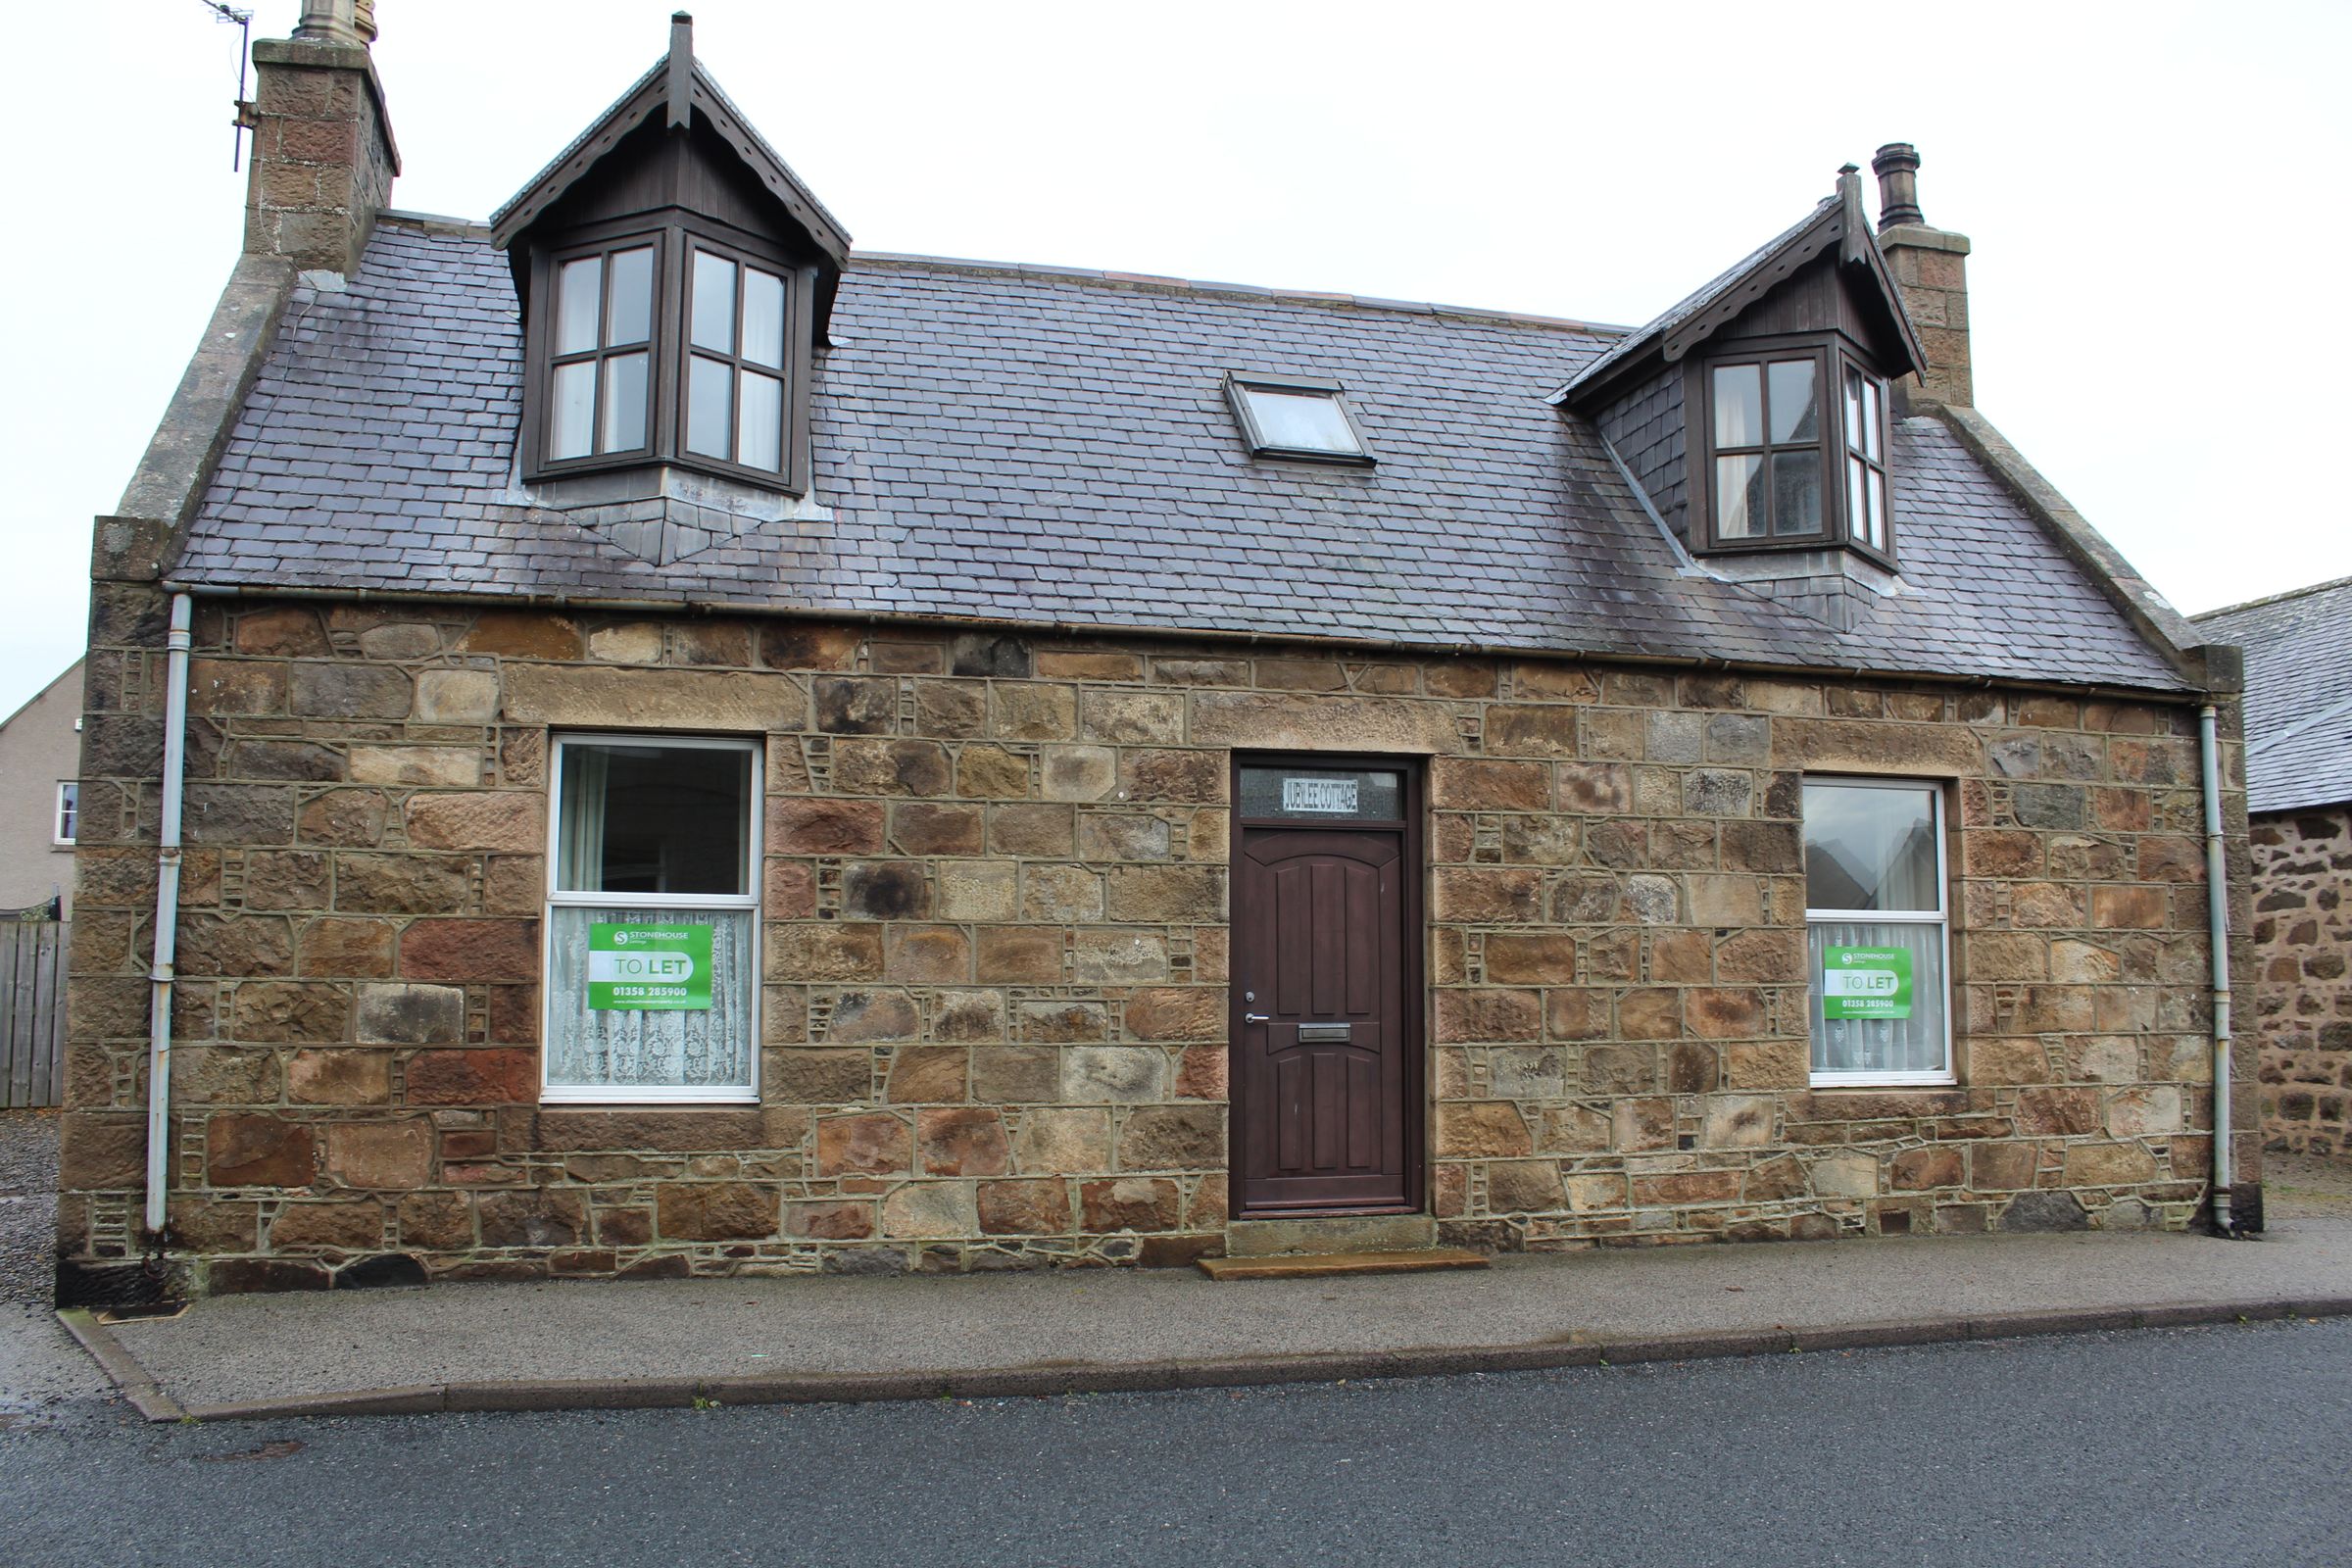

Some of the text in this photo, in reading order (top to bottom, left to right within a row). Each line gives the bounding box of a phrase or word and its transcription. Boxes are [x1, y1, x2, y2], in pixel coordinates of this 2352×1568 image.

[1286, 781, 1356, 810] JUBILEE COTTAGE
[629, 931, 689, 940] STONEHOUSE
[614, 958, 687, 975] TO LET
[1842, 976, 1893, 990] TO LET
[613, 987, 687, 997] 01358 285900
